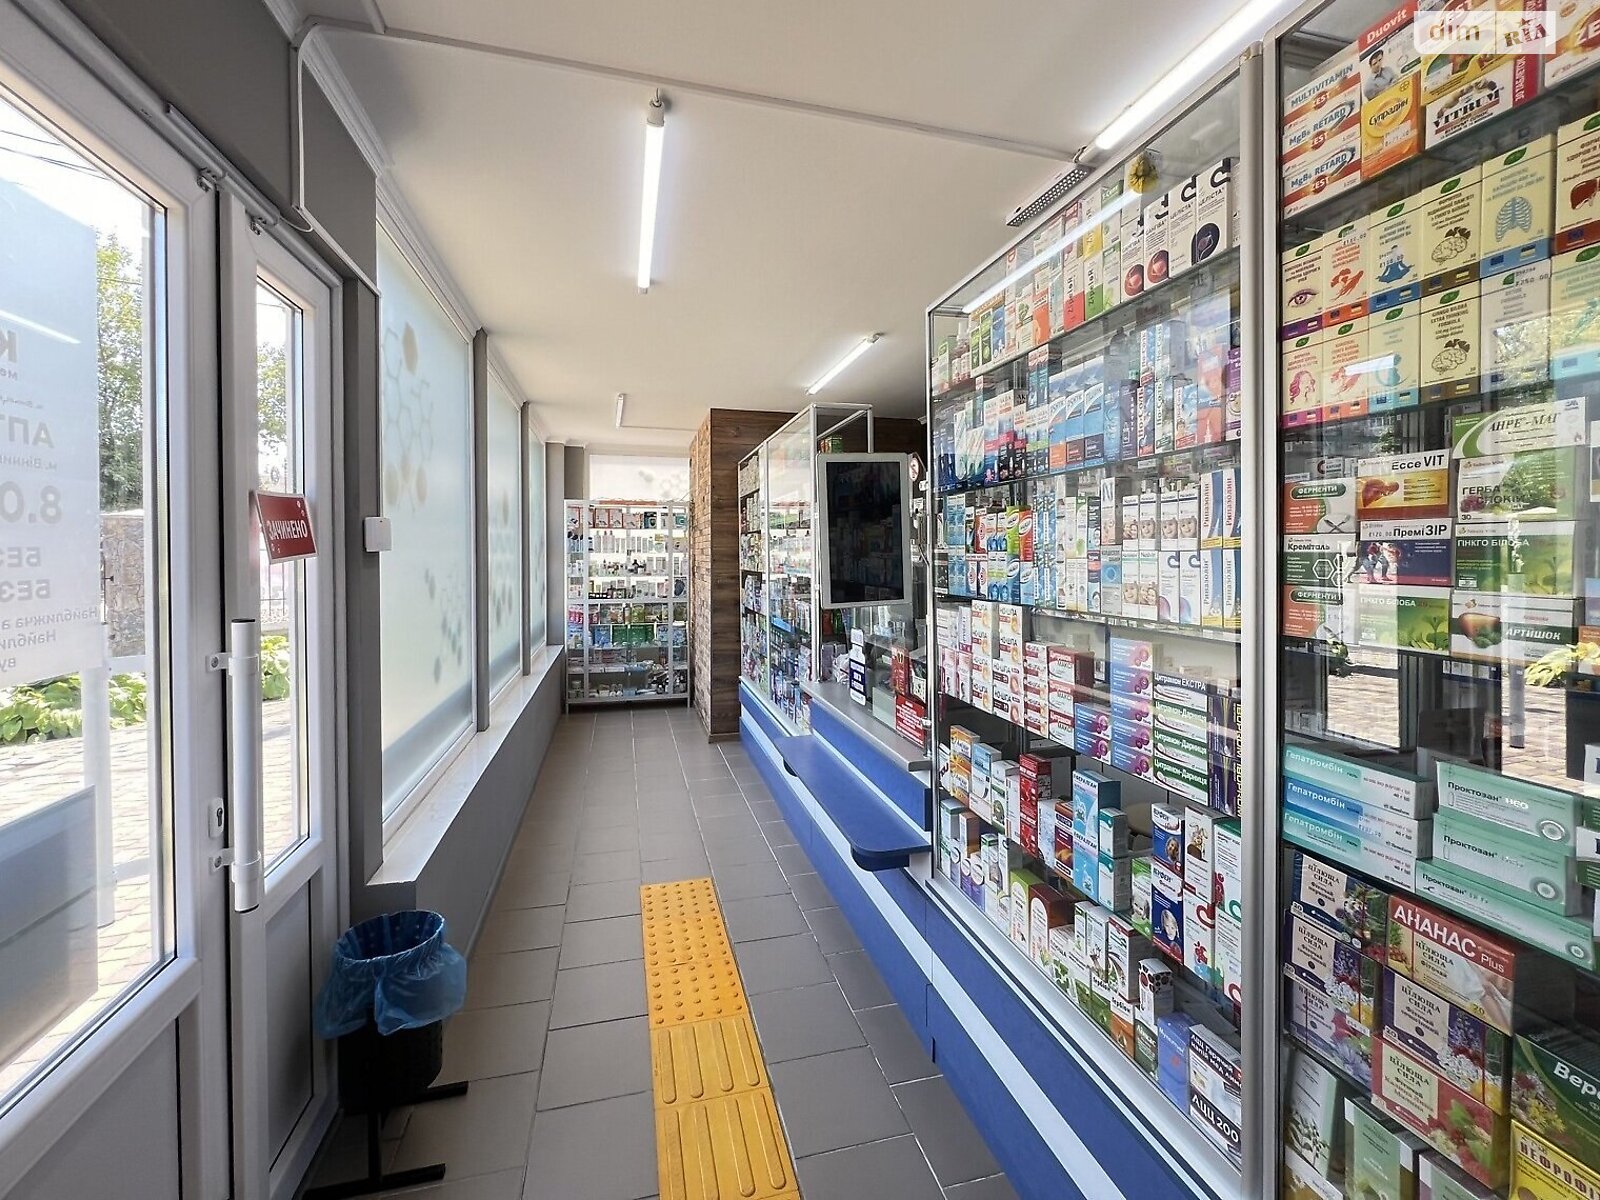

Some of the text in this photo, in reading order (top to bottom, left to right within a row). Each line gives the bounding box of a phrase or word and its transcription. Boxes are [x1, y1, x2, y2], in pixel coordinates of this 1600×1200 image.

[1366, 9, 1408, 44] Duovit
[1290, 63, 1354, 108] MULTIVITAMIN
[1312, 106, 1347, 132] RETARD
[1368, 97, 1409, 126] Супрадин
[1432, 88, 1500, 128] VITRUM
[1314, 152, 1348, 177] RETARD
[1391, 454, 1445, 471] Ecce VIT
[1297, 485, 1338, 495] ФЕРМЕНТИ
[1462, 485, 1501, 496] ГЕРБА
[266, 519, 309, 541] ЗАЧИНЕНО
[1287, 543, 1331, 552] Креміталь
[1457, 539, 1490, 548] ГІНКГО
[1296, 591, 1338, 600] ФЕРМЕНТИ
[1505, 628, 1561, 641] АРТИШОК
[1181, 678, 1207, 692] ЕКСТРА
[1285, 749, 1344, 775] Гепатромбін
[1286, 782, 1346, 810] Гепатромбін
[1447, 781, 1501, 803] Проктозан
[1284, 812, 1344, 841] Гепатромбін
[1443, 834, 1499, 859] Проктозан
[1313, 873, 1334, 887] СИЛА
[1422, 872, 1468, 896] Проктозан
[1393, 904, 1477, 958] АНАНАС
[1303, 935, 1323, 952] СИЛА
[1422, 951, 1447, 969] СИЛА
[1480, 953, 1505, 974] Plus
[1408, 997, 1434, 1017] СИЛА
[1396, 1067, 1422, 1088] СИЛА
[1191, 1094, 1239, 1143] АЦЦ 200
